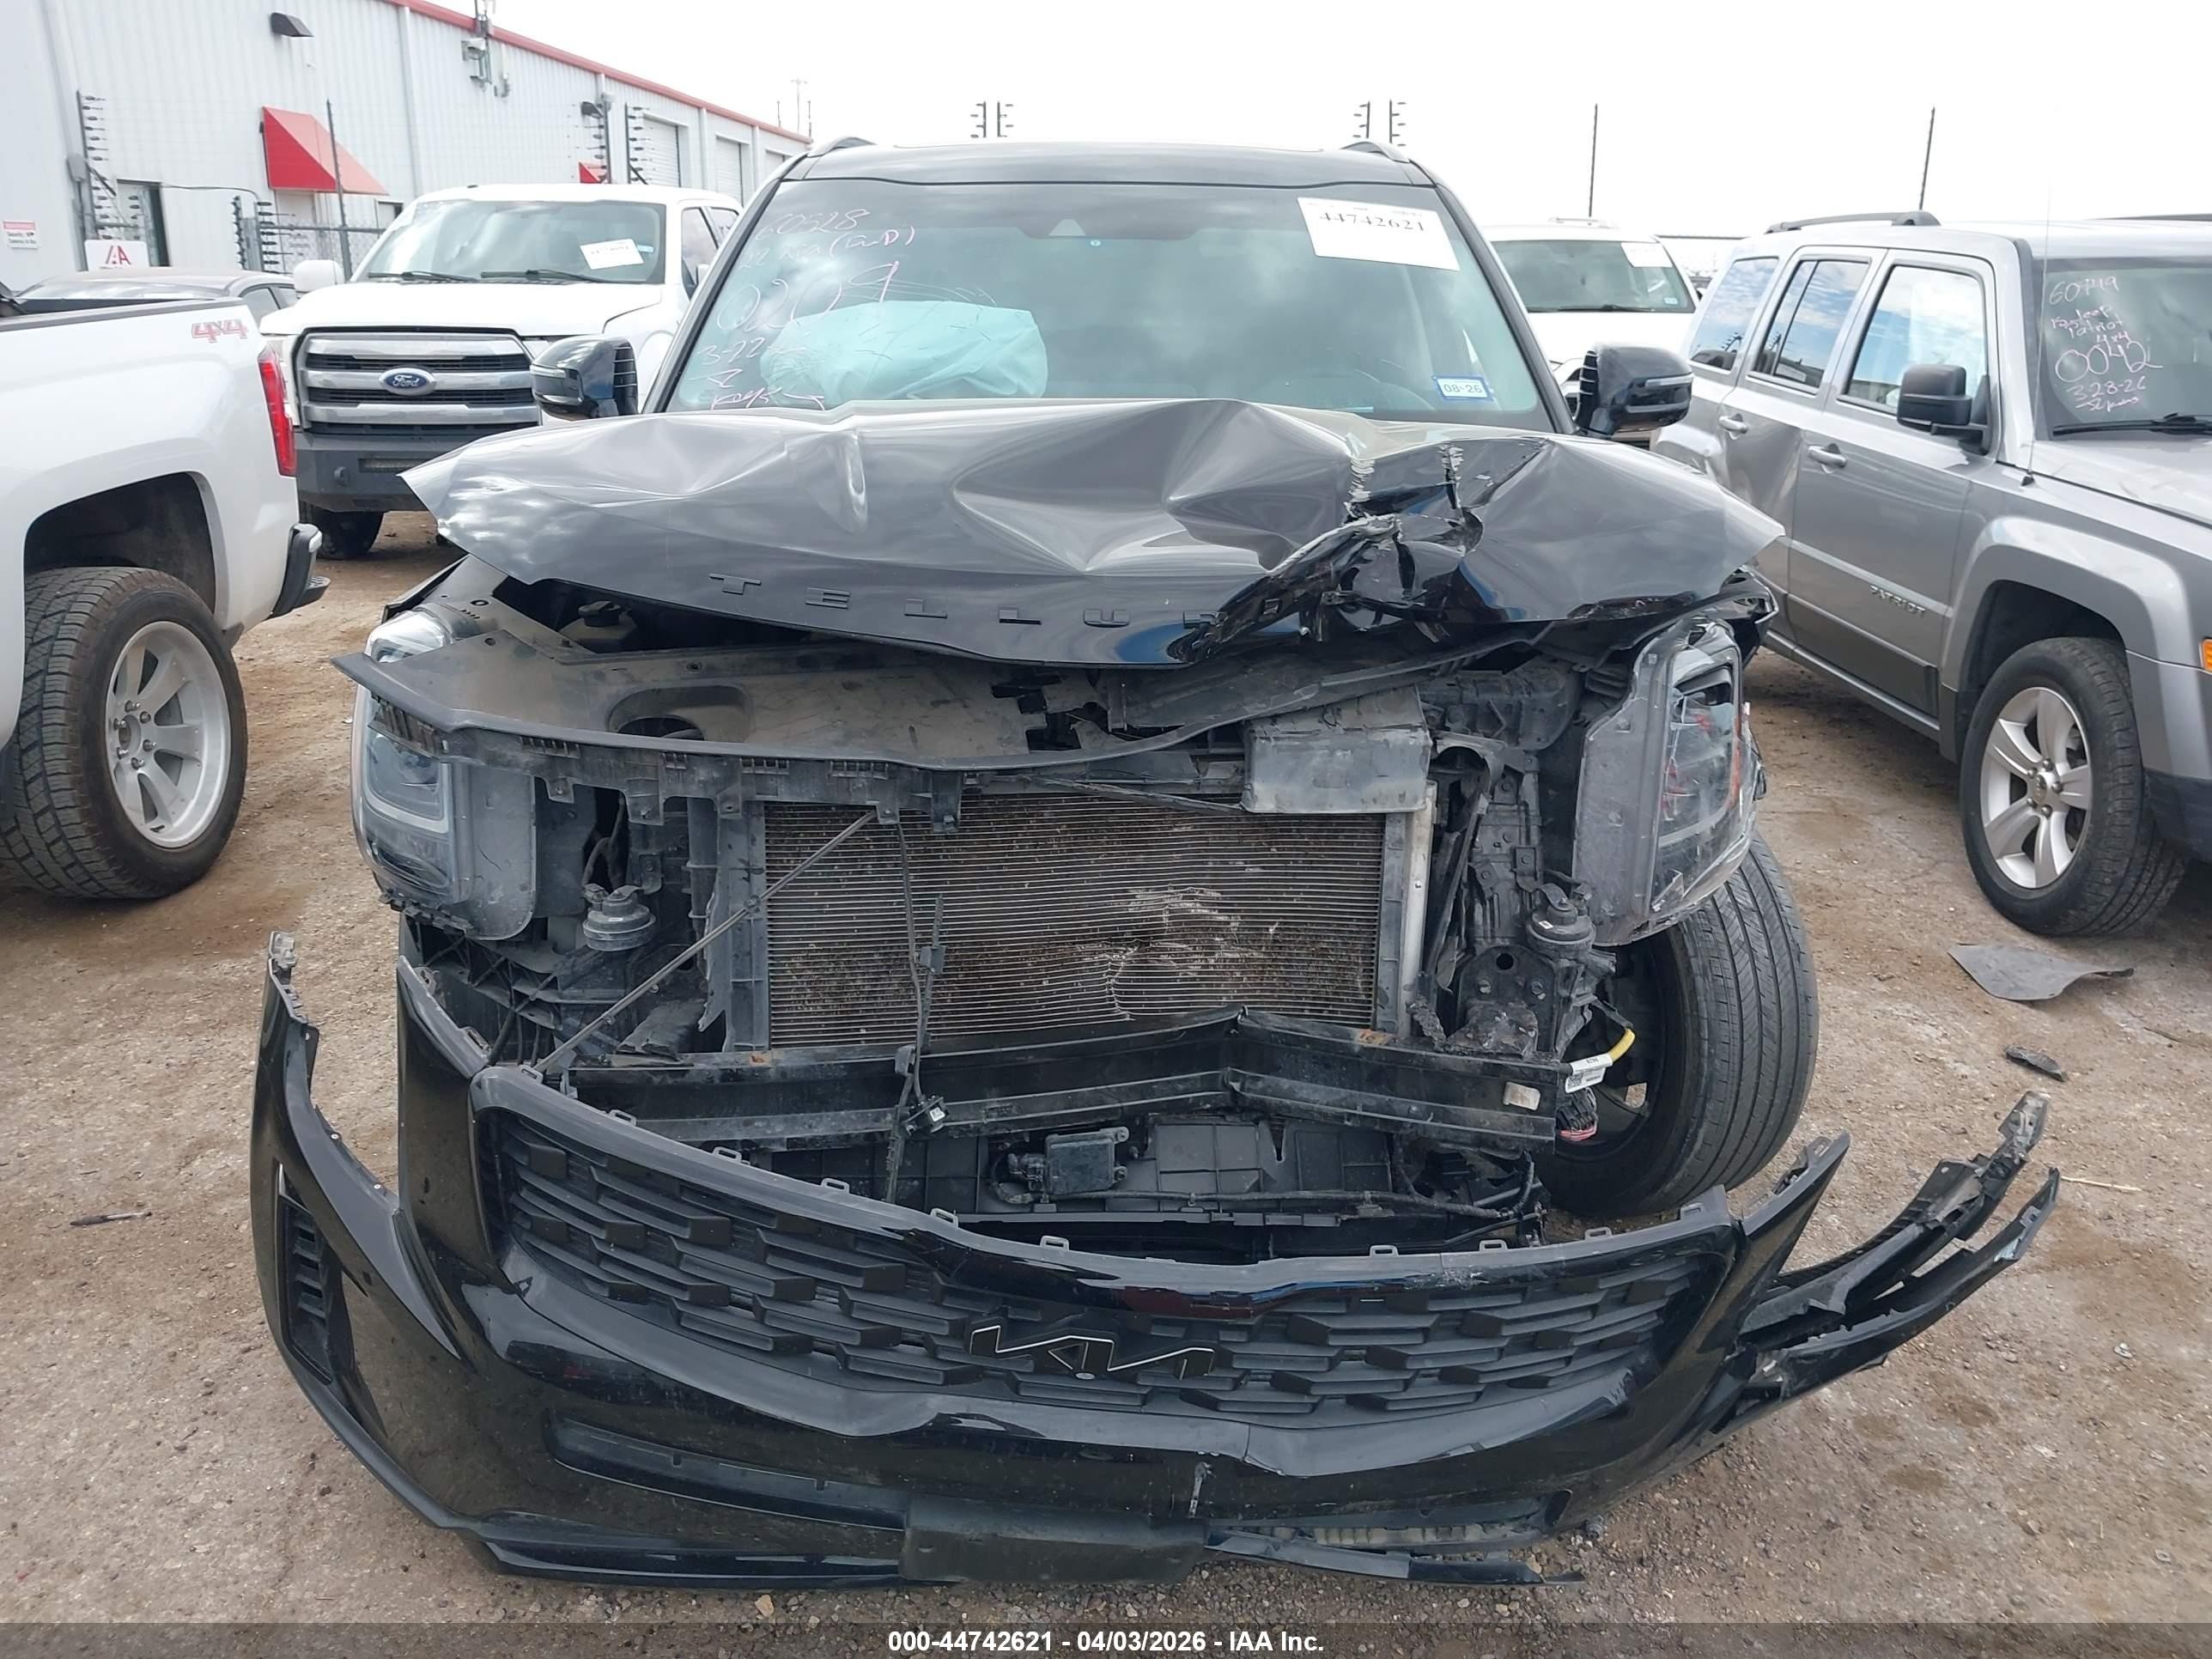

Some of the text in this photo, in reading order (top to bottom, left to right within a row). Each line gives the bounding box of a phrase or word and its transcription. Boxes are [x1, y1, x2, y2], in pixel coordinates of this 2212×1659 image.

[1320, 212, 1425, 232] 44742621
[392, 375, 420, 386] Ford
[969, 1324, 1217, 1382] KIA
